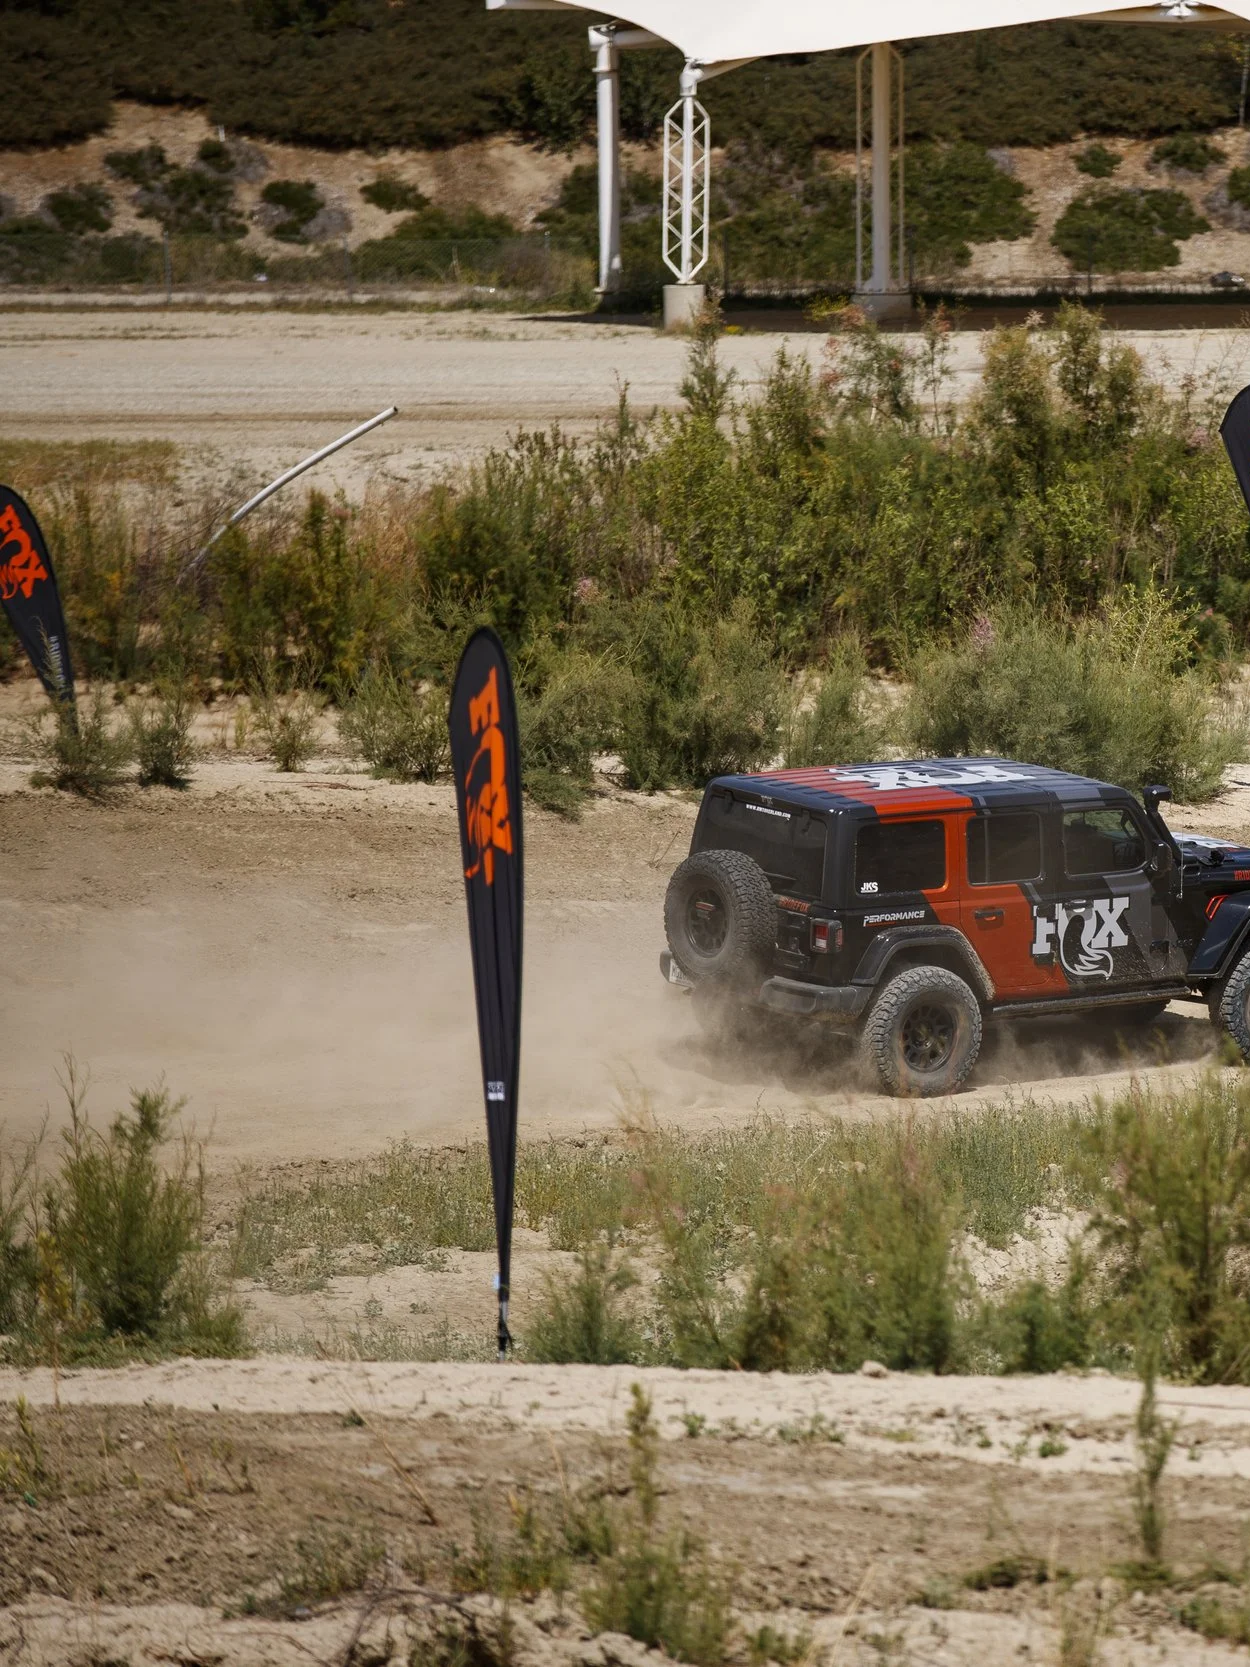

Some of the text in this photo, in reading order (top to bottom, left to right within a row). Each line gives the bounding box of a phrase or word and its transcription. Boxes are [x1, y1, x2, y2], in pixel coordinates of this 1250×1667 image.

[465, 666, 513, 886] FOX
[861, 882, 879, 893] JKS
[863, 911, 925, 927] PERFORMANCE
[1033, 897, 1129, 980] FOX
